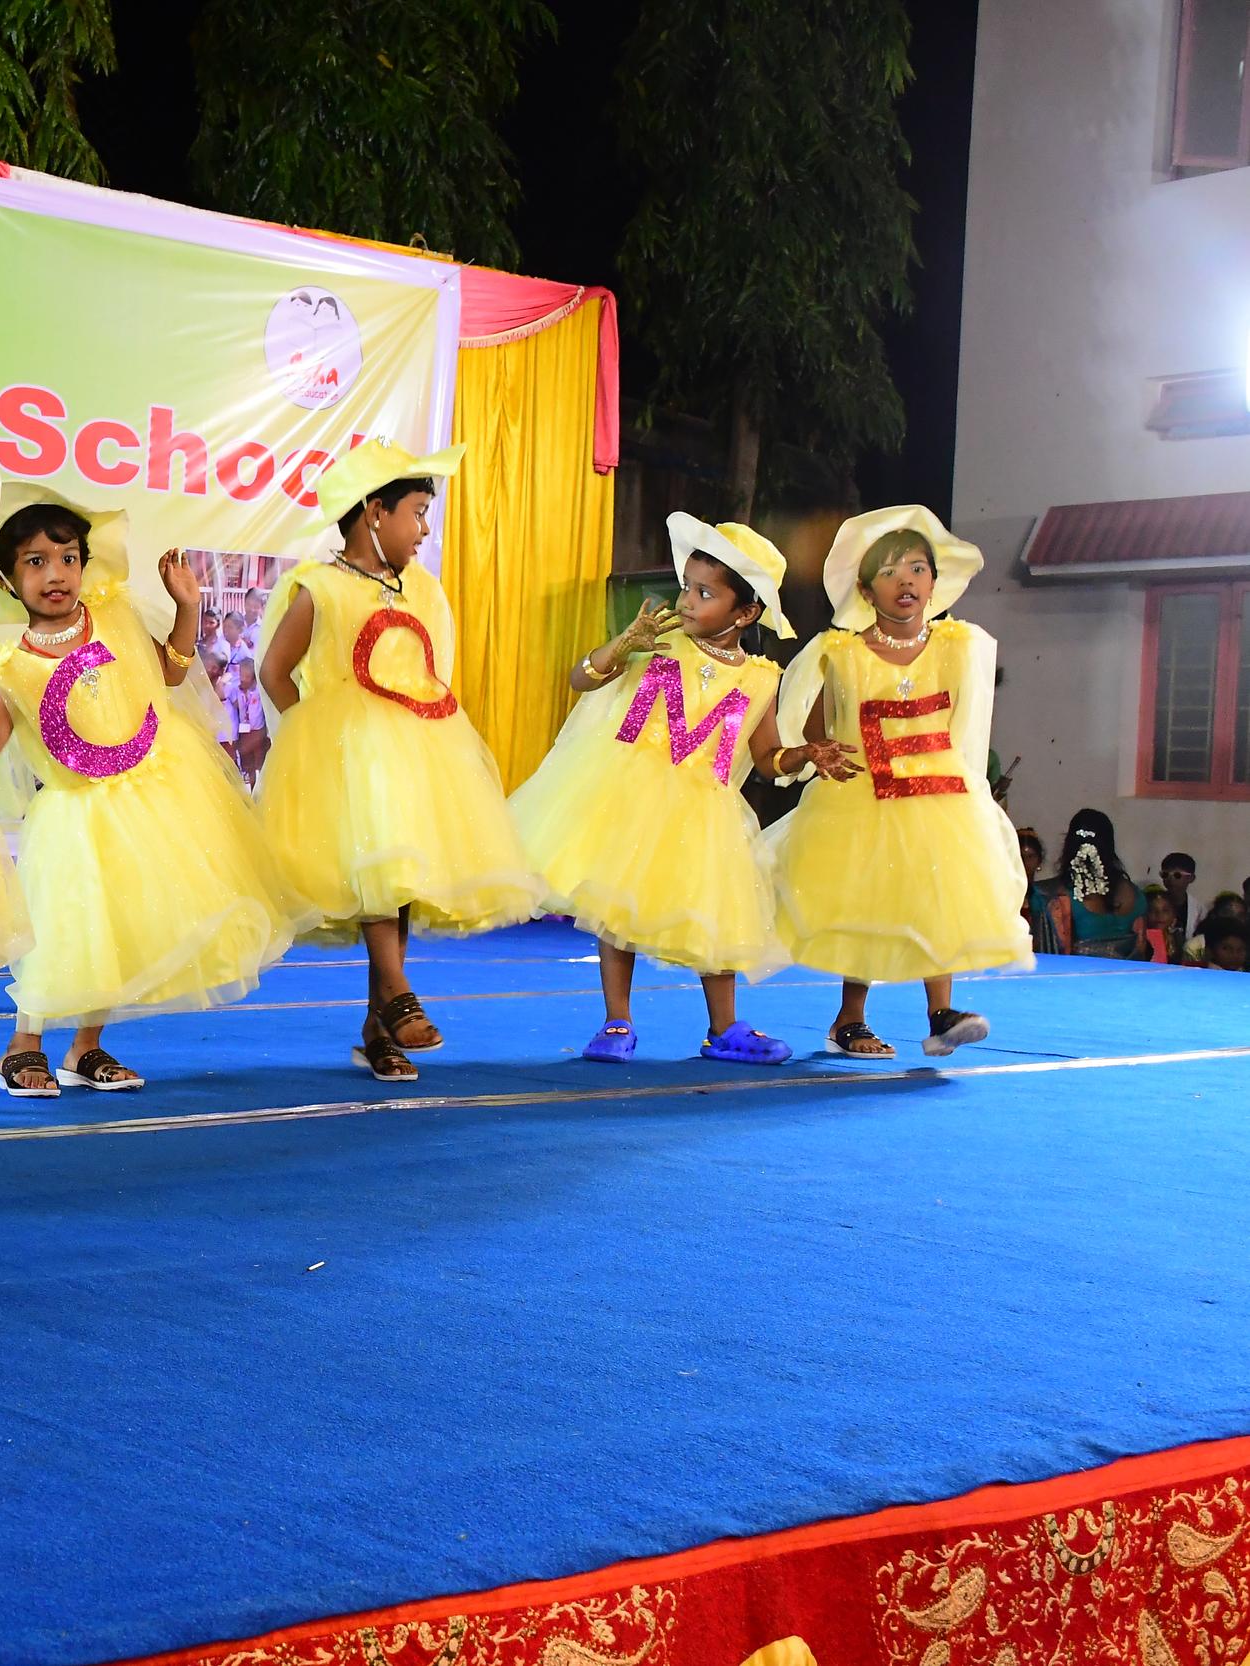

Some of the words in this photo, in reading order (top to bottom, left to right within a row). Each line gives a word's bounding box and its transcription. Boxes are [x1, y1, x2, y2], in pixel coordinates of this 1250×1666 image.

[39, 639, 160, 777] C
[616, 652, 751, 787] M
[859, 690, 969, 801] E
